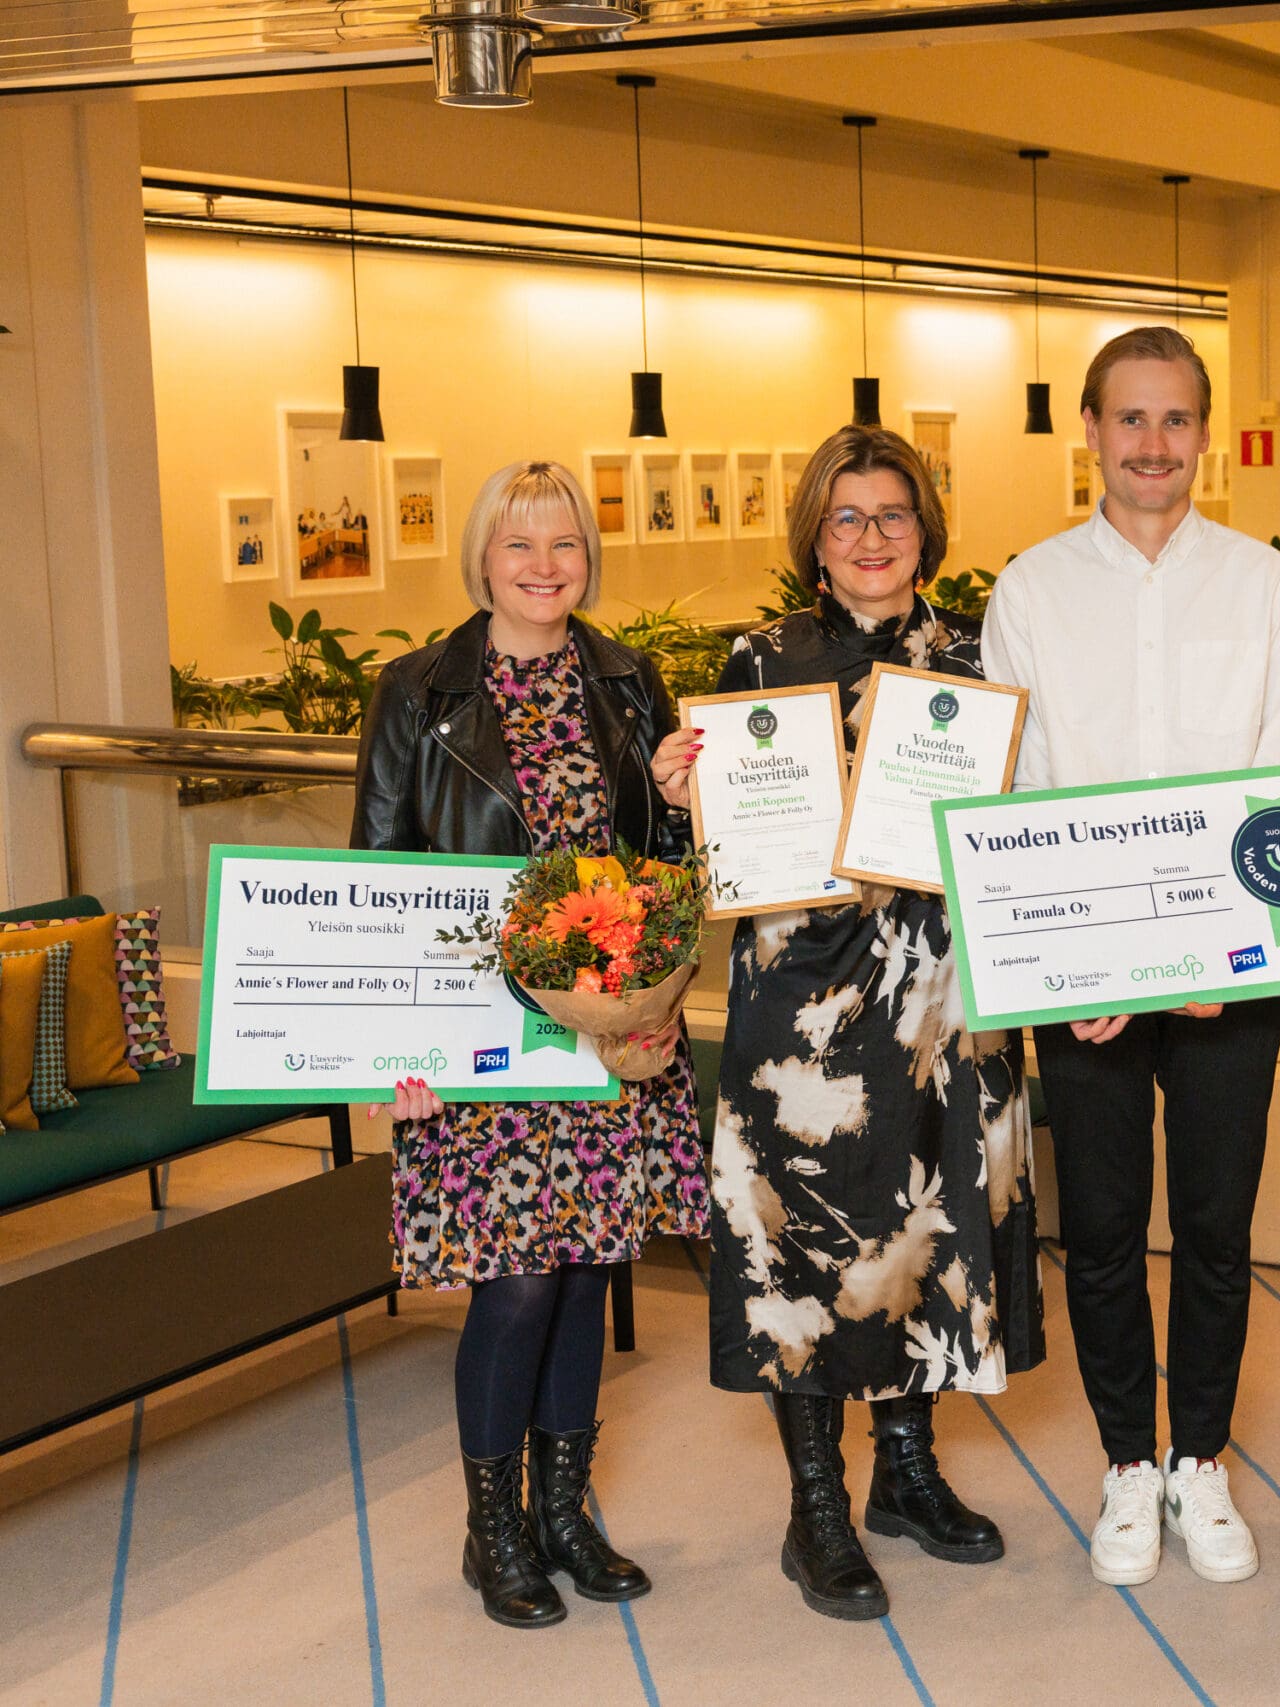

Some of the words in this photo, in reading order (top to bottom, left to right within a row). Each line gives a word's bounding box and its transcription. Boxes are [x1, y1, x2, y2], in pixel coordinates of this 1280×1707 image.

[912, 733, 964, 754] Vuoden
[739, 755, 794, 770] Vuoden
[896, 743, 976, 770] Uusyrittäjä
[728, 766, 809, 785] Uusyrittäjä
[910, 788, 933, 798] Famula
[762, 795, 805, 808] Koponen
[964, 827, 1060, 854] Vuoden
[1068, 810, 1208, 844] Uusyrittäjä
[1153, 864, 1190, 876] Summa
[1244, 847, 1278, 892] Vuoden
[984, 882, 1011, 894] Saaja
[239, 880, 338, 906] Vuoden
[348, 883, 490, 916] Uusyrittäjä
[1166, 891, 1174, 904] 5
[1178, 888, 1204, 903] 000
[1208, 886, 1216, 899] €
[1012, 904, 1066, 921] Famula
[1070, 902, 1092, 916] Oy
[308, 920, 353, 934] Yleisön
[356, 922, 405, 934] suosikki
[246, 946, 274, 959] Saaja
[423, 950, 460, 960] Summa
[1232, 952, 1263, 966] PRH
[992, 955, 1040, 967] Lahjoittajat
[286, 976, 328, 989] Flower
[332, 978, 354, 990] and
[358, 978, 389, 992] Folly
[392, 978, 411, 992] Oy
[434, 979, 440, 990] 2
[444, 979, 466, 990] 500
[468, 979, 476, 990] €
[1070, 981, 1100, 989] keskus
[236, 1030, 286, 1040] Lahjoittajat
[536, 1024, 566, 1035] 2025
[310, 1062, 340, 1070] keskus
[476, 1054, 506, 1067] PRH
